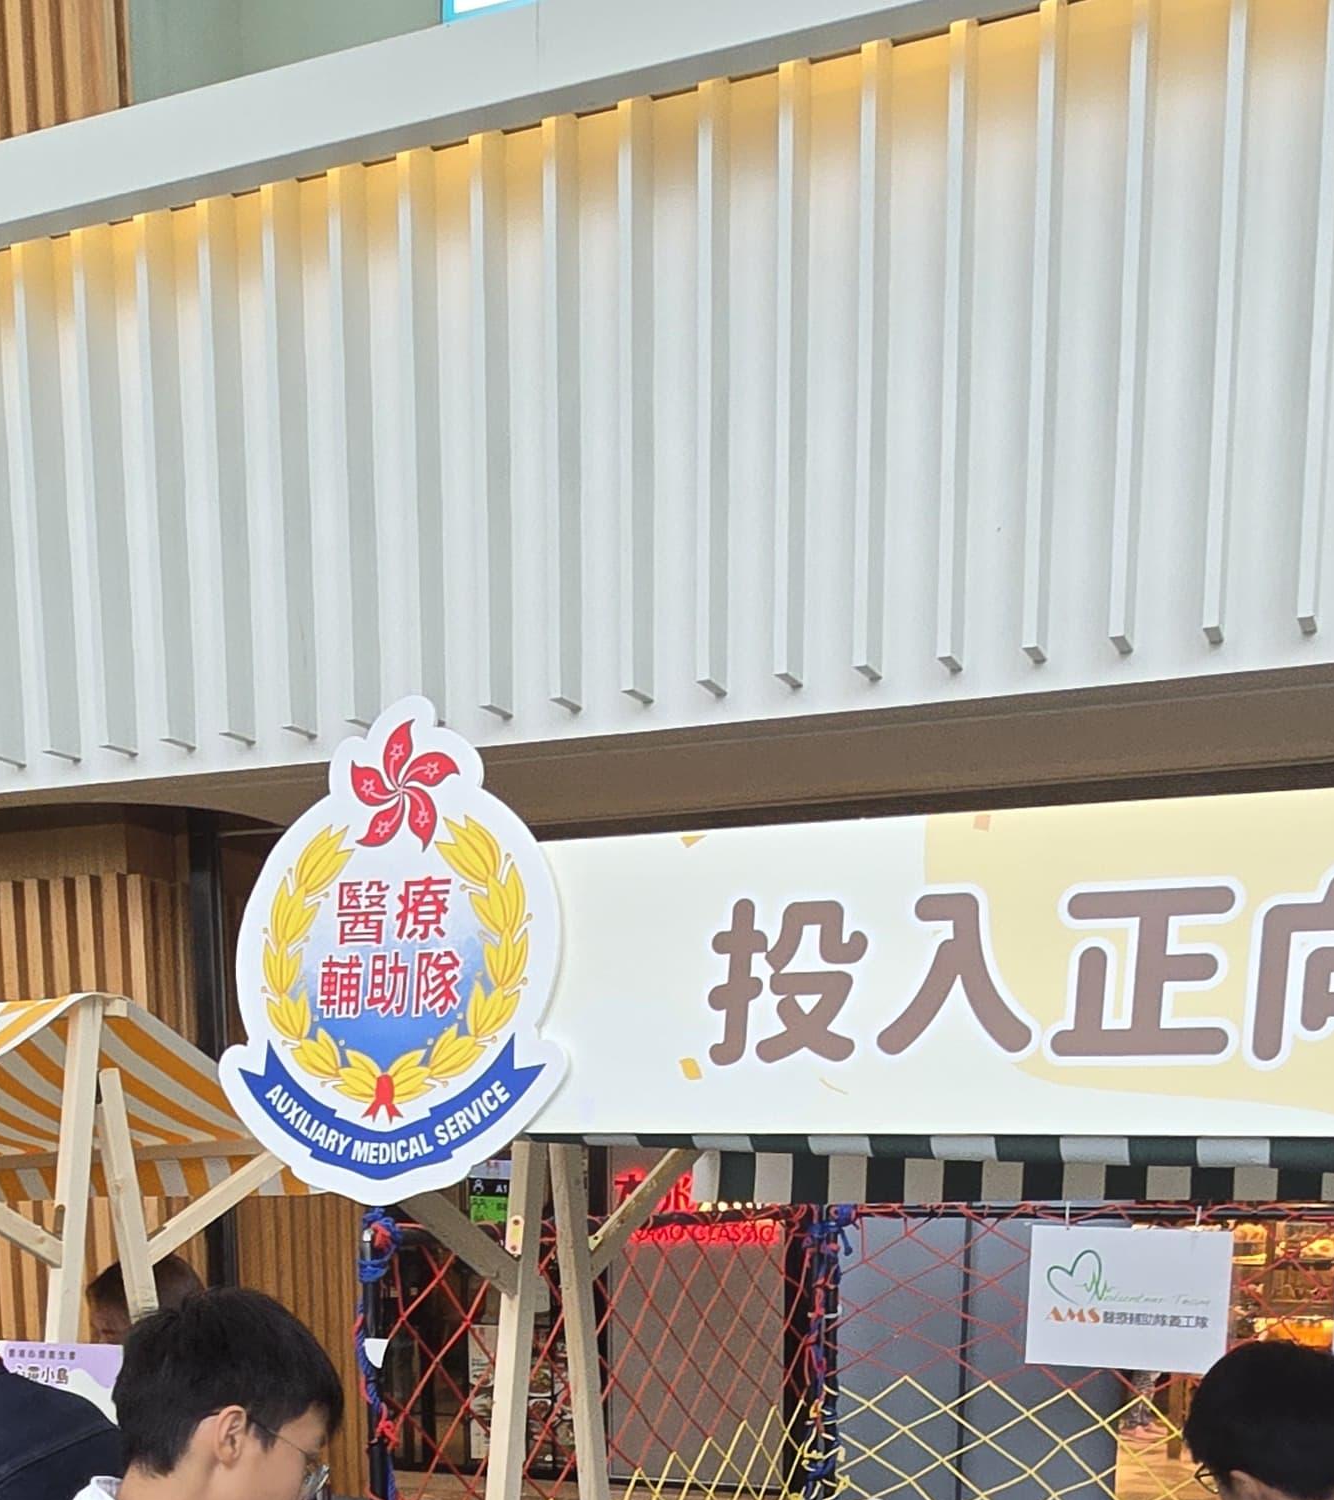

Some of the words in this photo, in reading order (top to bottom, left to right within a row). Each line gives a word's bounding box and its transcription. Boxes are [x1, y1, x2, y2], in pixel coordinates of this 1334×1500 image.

[335, 874, 453, 947] 醫療
[317, 949, 462, 1020] 輔助隊
[264, 1082, 350, 1157] AUXILIARY
[351, 1130, 435, 1166] MEDICAL
[433, 1080, 512, 1147] SERVICE
[1045, 1305, 1101, 1325] AMS
